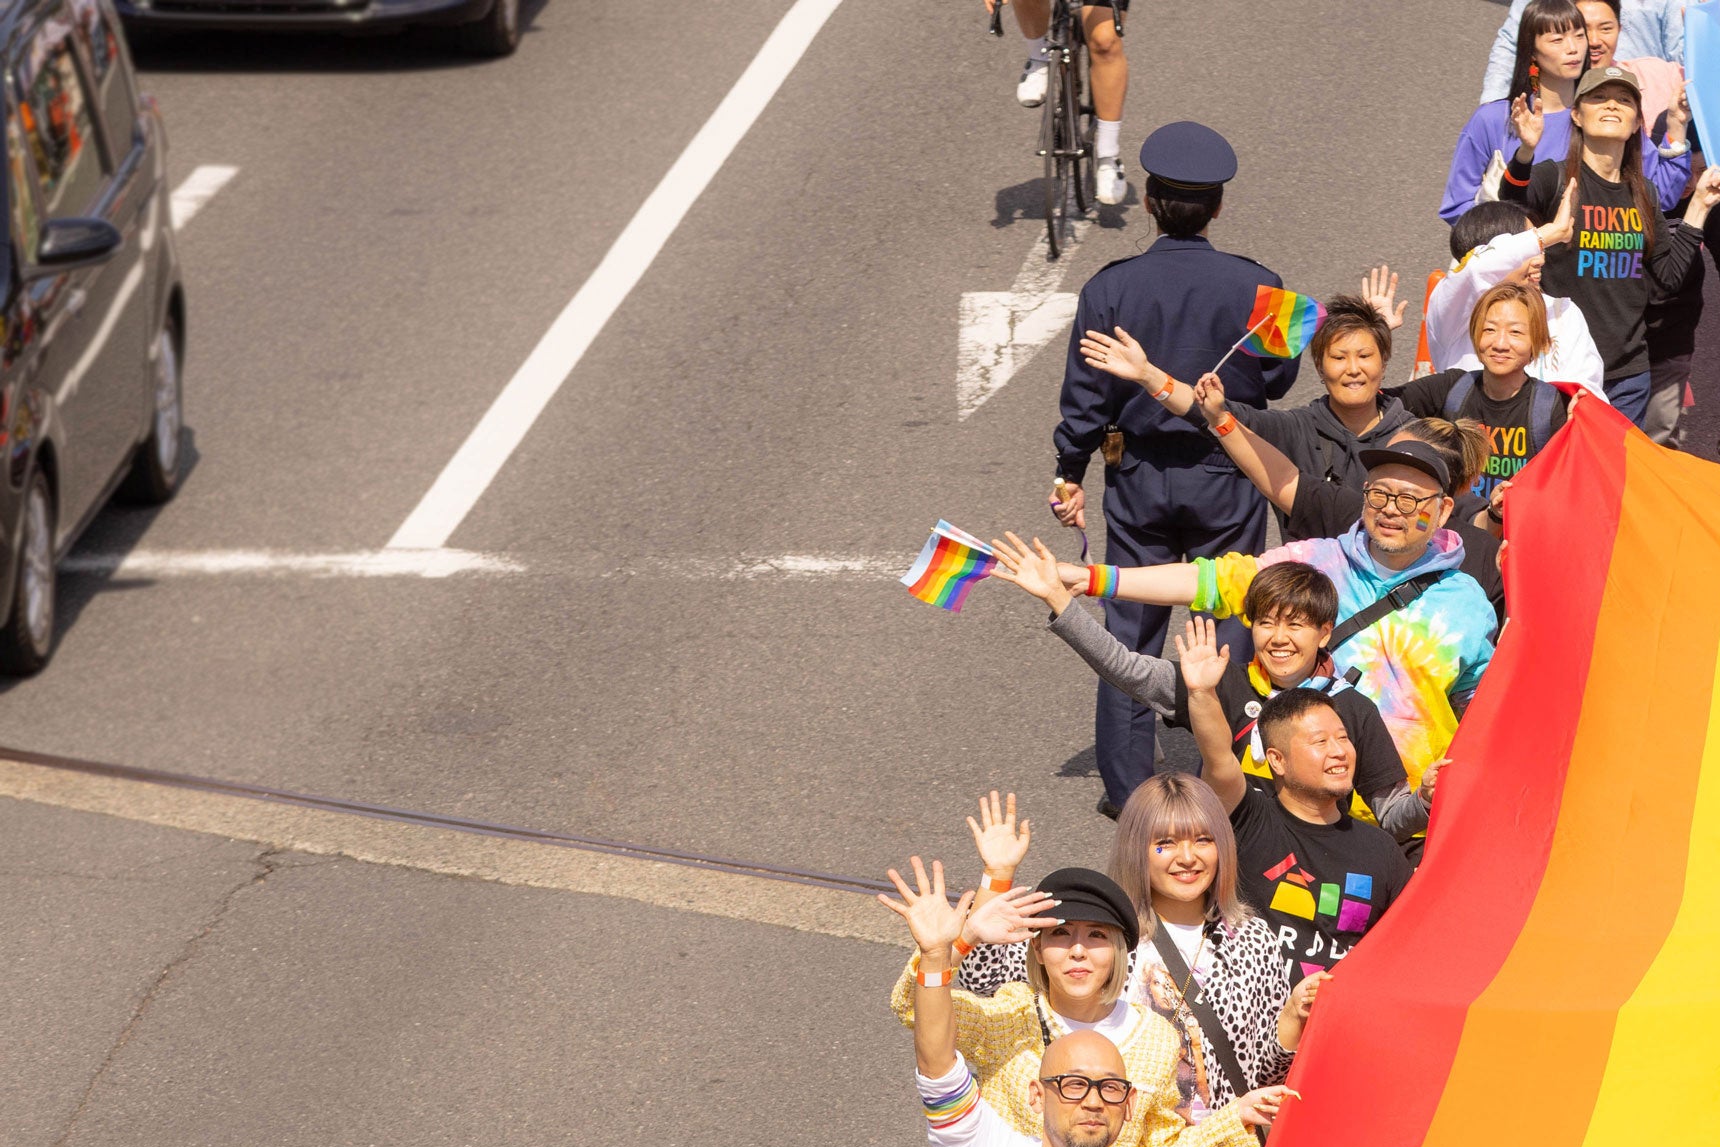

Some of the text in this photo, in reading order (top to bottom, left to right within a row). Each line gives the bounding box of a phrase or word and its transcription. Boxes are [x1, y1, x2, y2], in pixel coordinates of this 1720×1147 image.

[1581, 204, 1643, 232] TOKYO
[1579, 230, 1644, 250] RAINBOW
[1477, 423, 1527, 457] KYO
